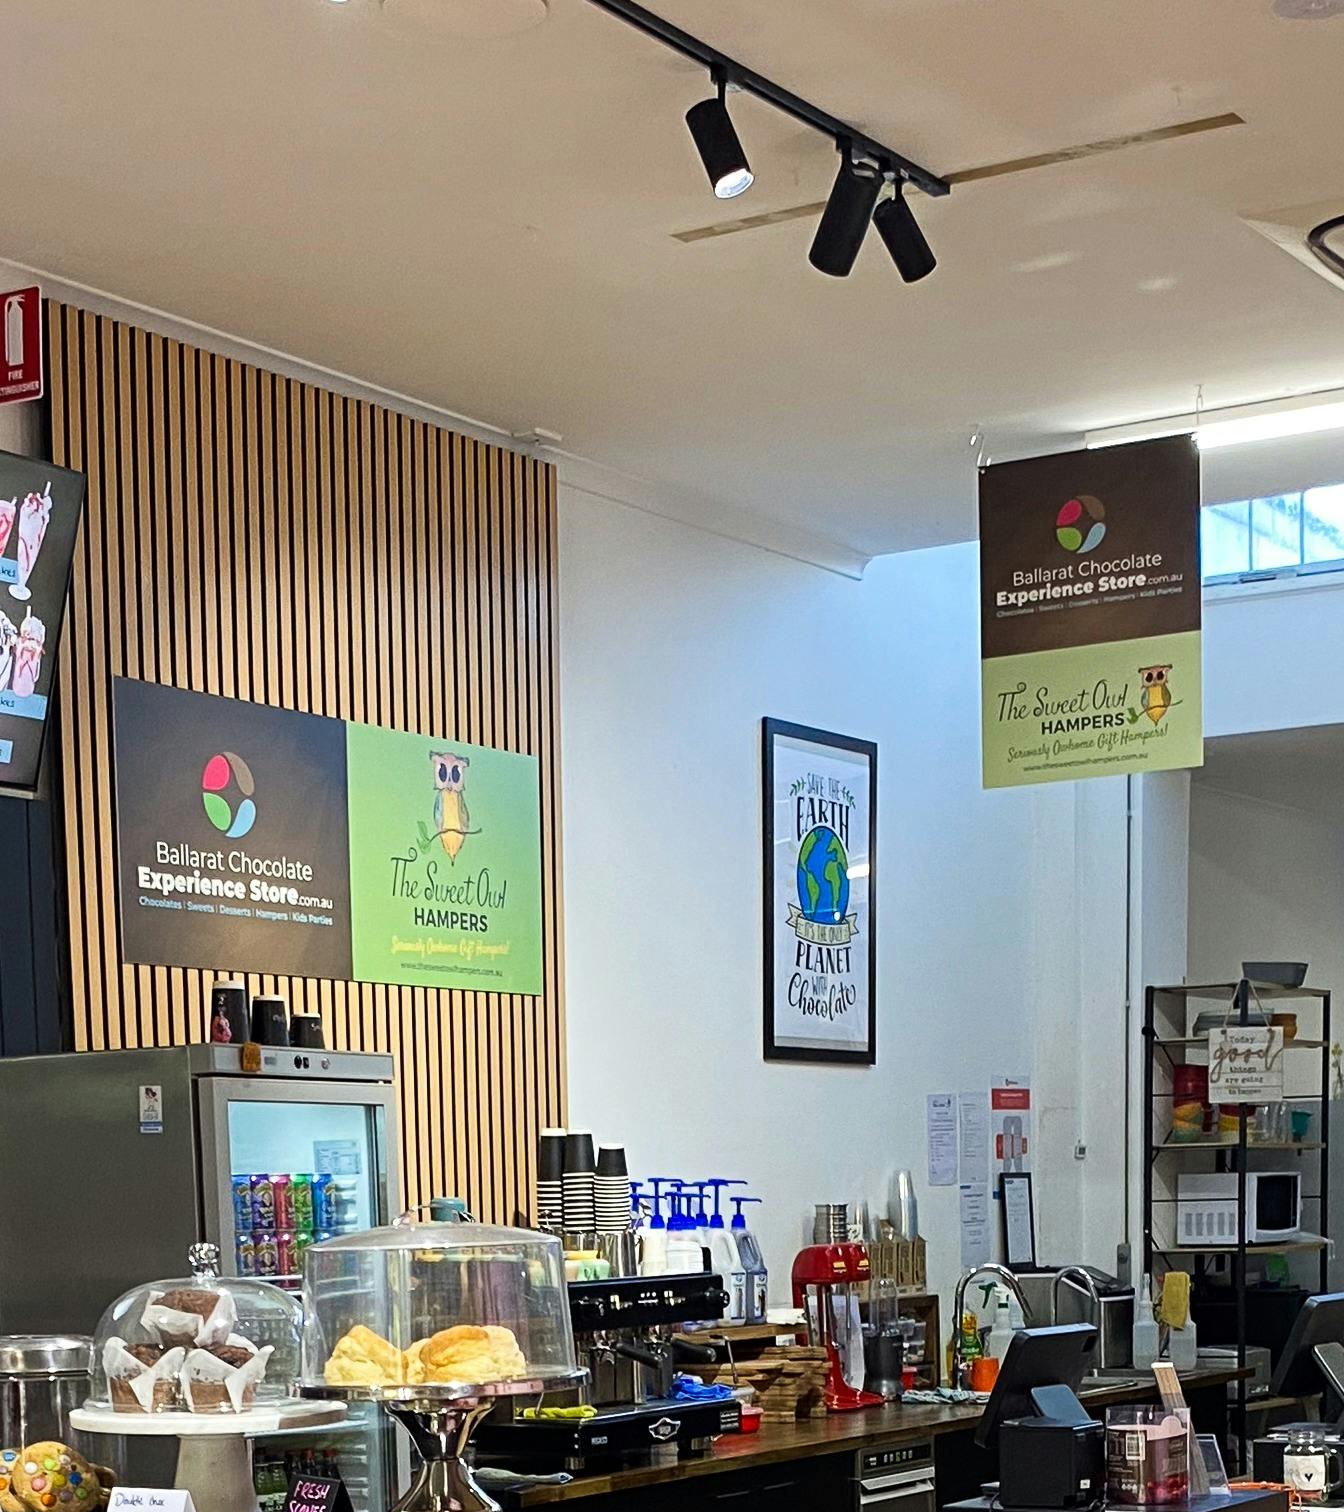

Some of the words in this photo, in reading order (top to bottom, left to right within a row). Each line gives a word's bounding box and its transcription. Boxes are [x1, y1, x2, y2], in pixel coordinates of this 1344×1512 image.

[998, 682, 1030, 722] The
[1033, 687, 1093, 718] Sweet
[1093, 679, 1128, 710] Owl
[1041, 712, 1125, 735] HAMPERS
[797, 797, 849, 852] EARTH
[156, 841, 225, 871] Ballarat
[228, 851, 313, 882] Chocolate
[391, 847, 421, 899] The
[424, 861, 475, 905] Sweet
[477, 868, 507, 908] Owl
[138, 866, 246, 899] Experience
[414, 907, 488, 933] HAMPERS
[796, 941, 851, 974] PLANET
[788, 972, 856, 1022] Chocolate
[294, 1480, 330, 1500] FRESH
